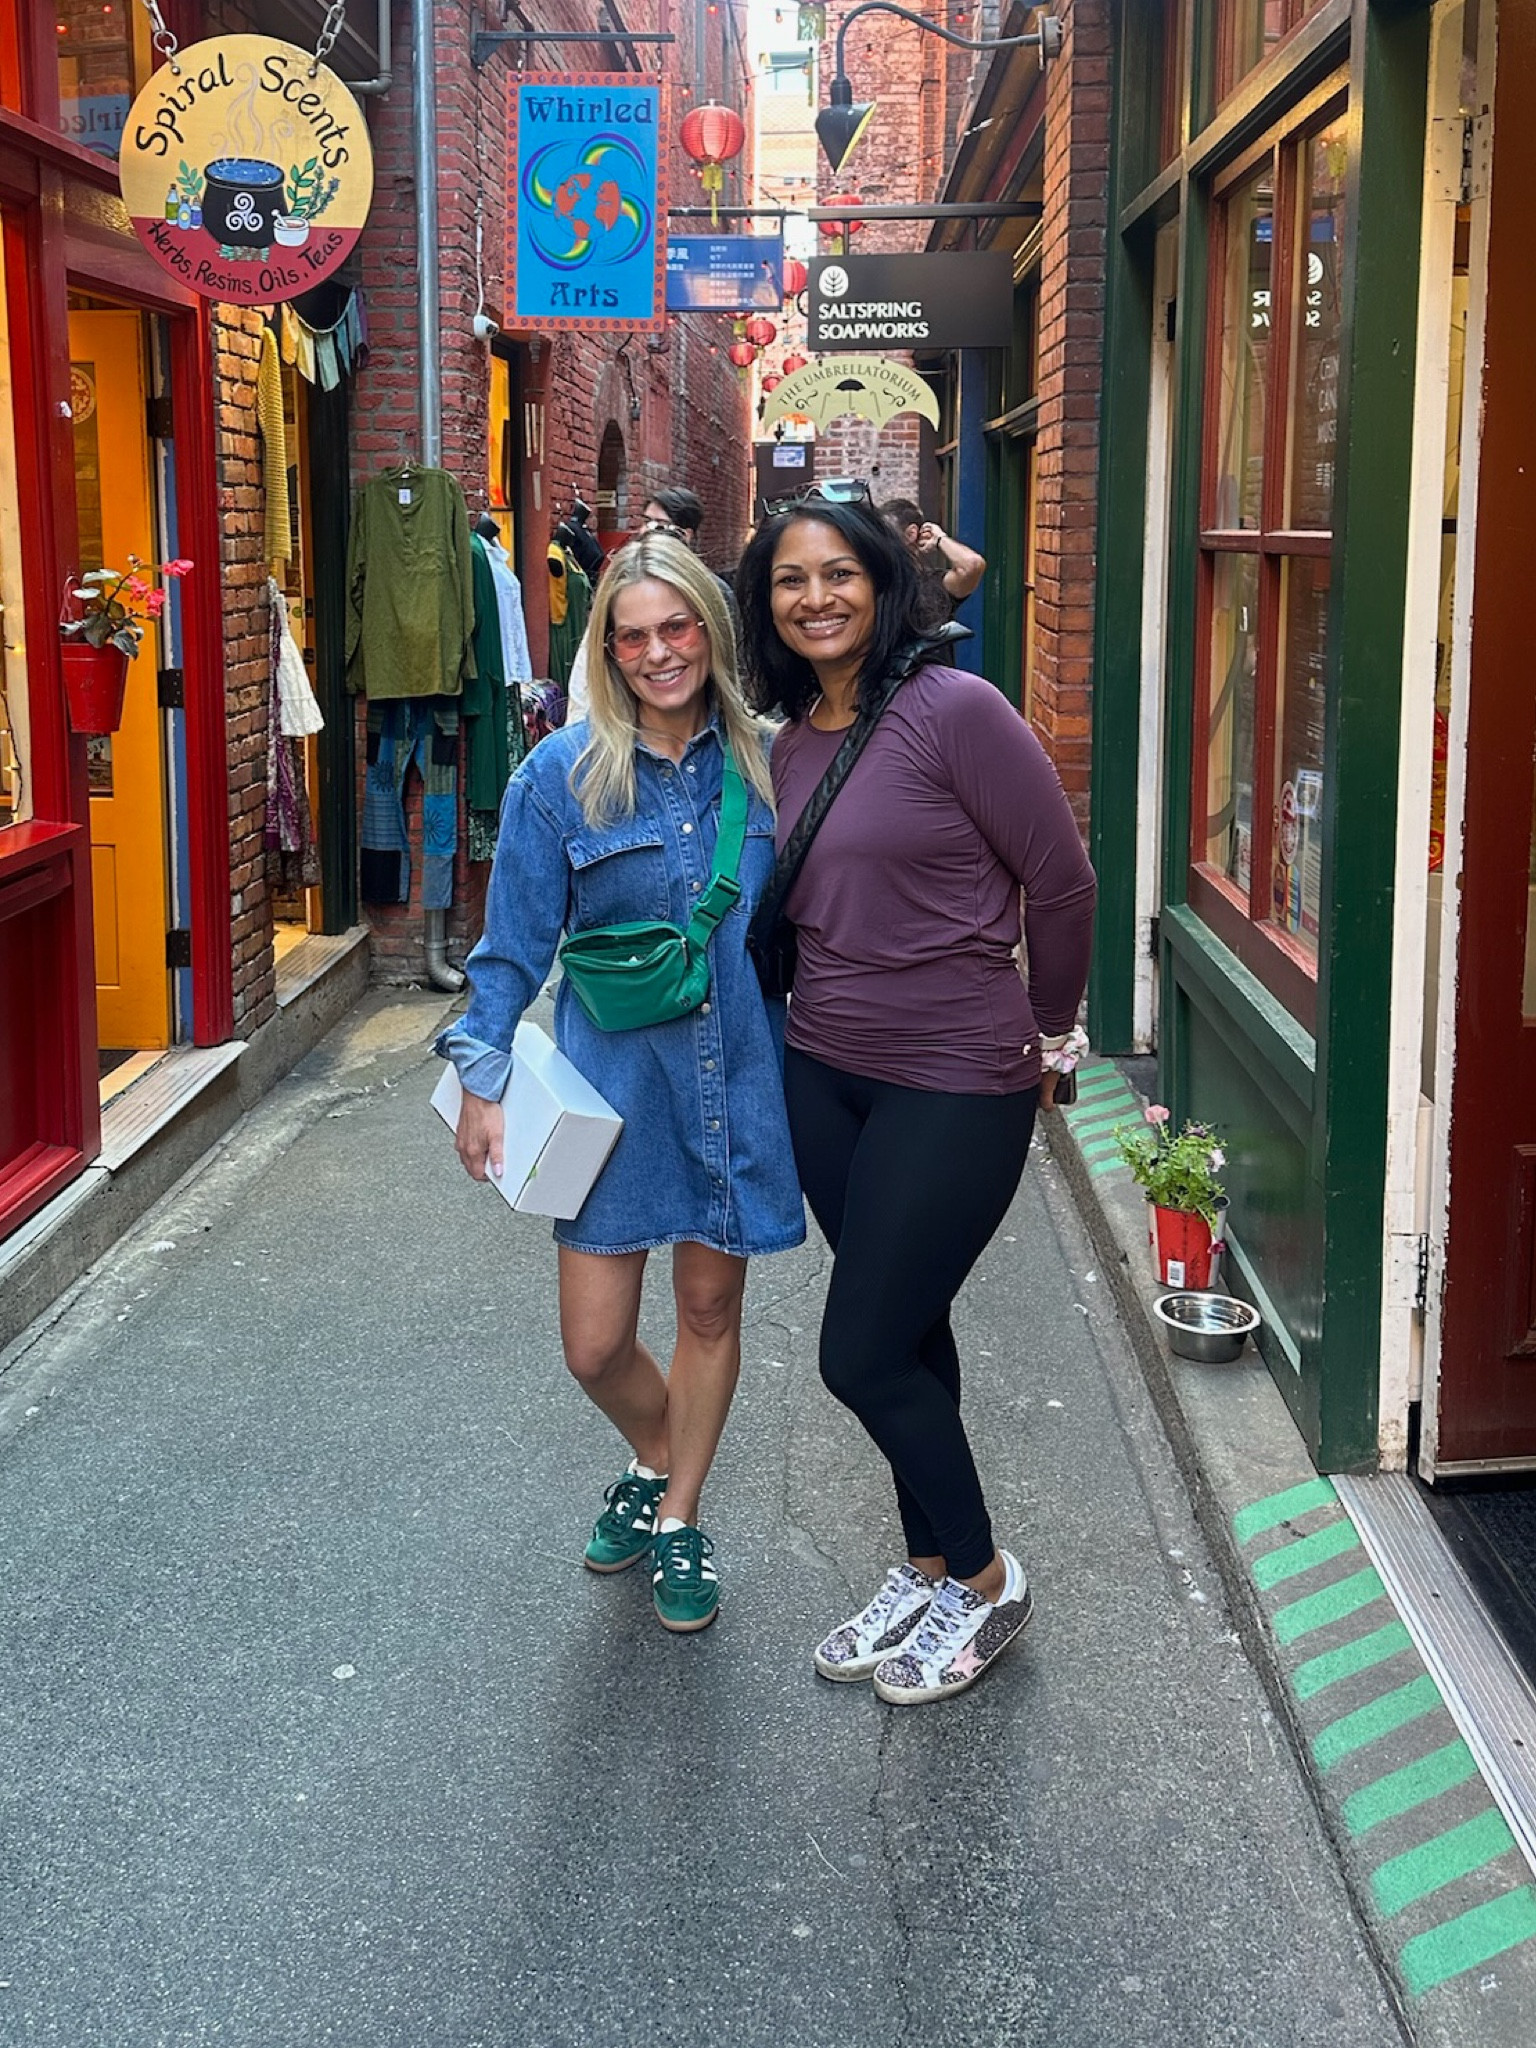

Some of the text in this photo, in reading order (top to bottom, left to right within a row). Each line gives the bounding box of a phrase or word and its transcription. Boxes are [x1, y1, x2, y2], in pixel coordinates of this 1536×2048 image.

[135, 52, 350, 168] Spiral Scents
[525, 96, 654, 124] Whirled
[298, 232, 344, 271] Teas
[551, 282, 619, 308] Arts
[818, 301, 922, 320] SALTSPRING
[818, 321, 930, 340] SOAPWORKS
[778, 363, 922, 406] THE UMBRELLATORIUM
